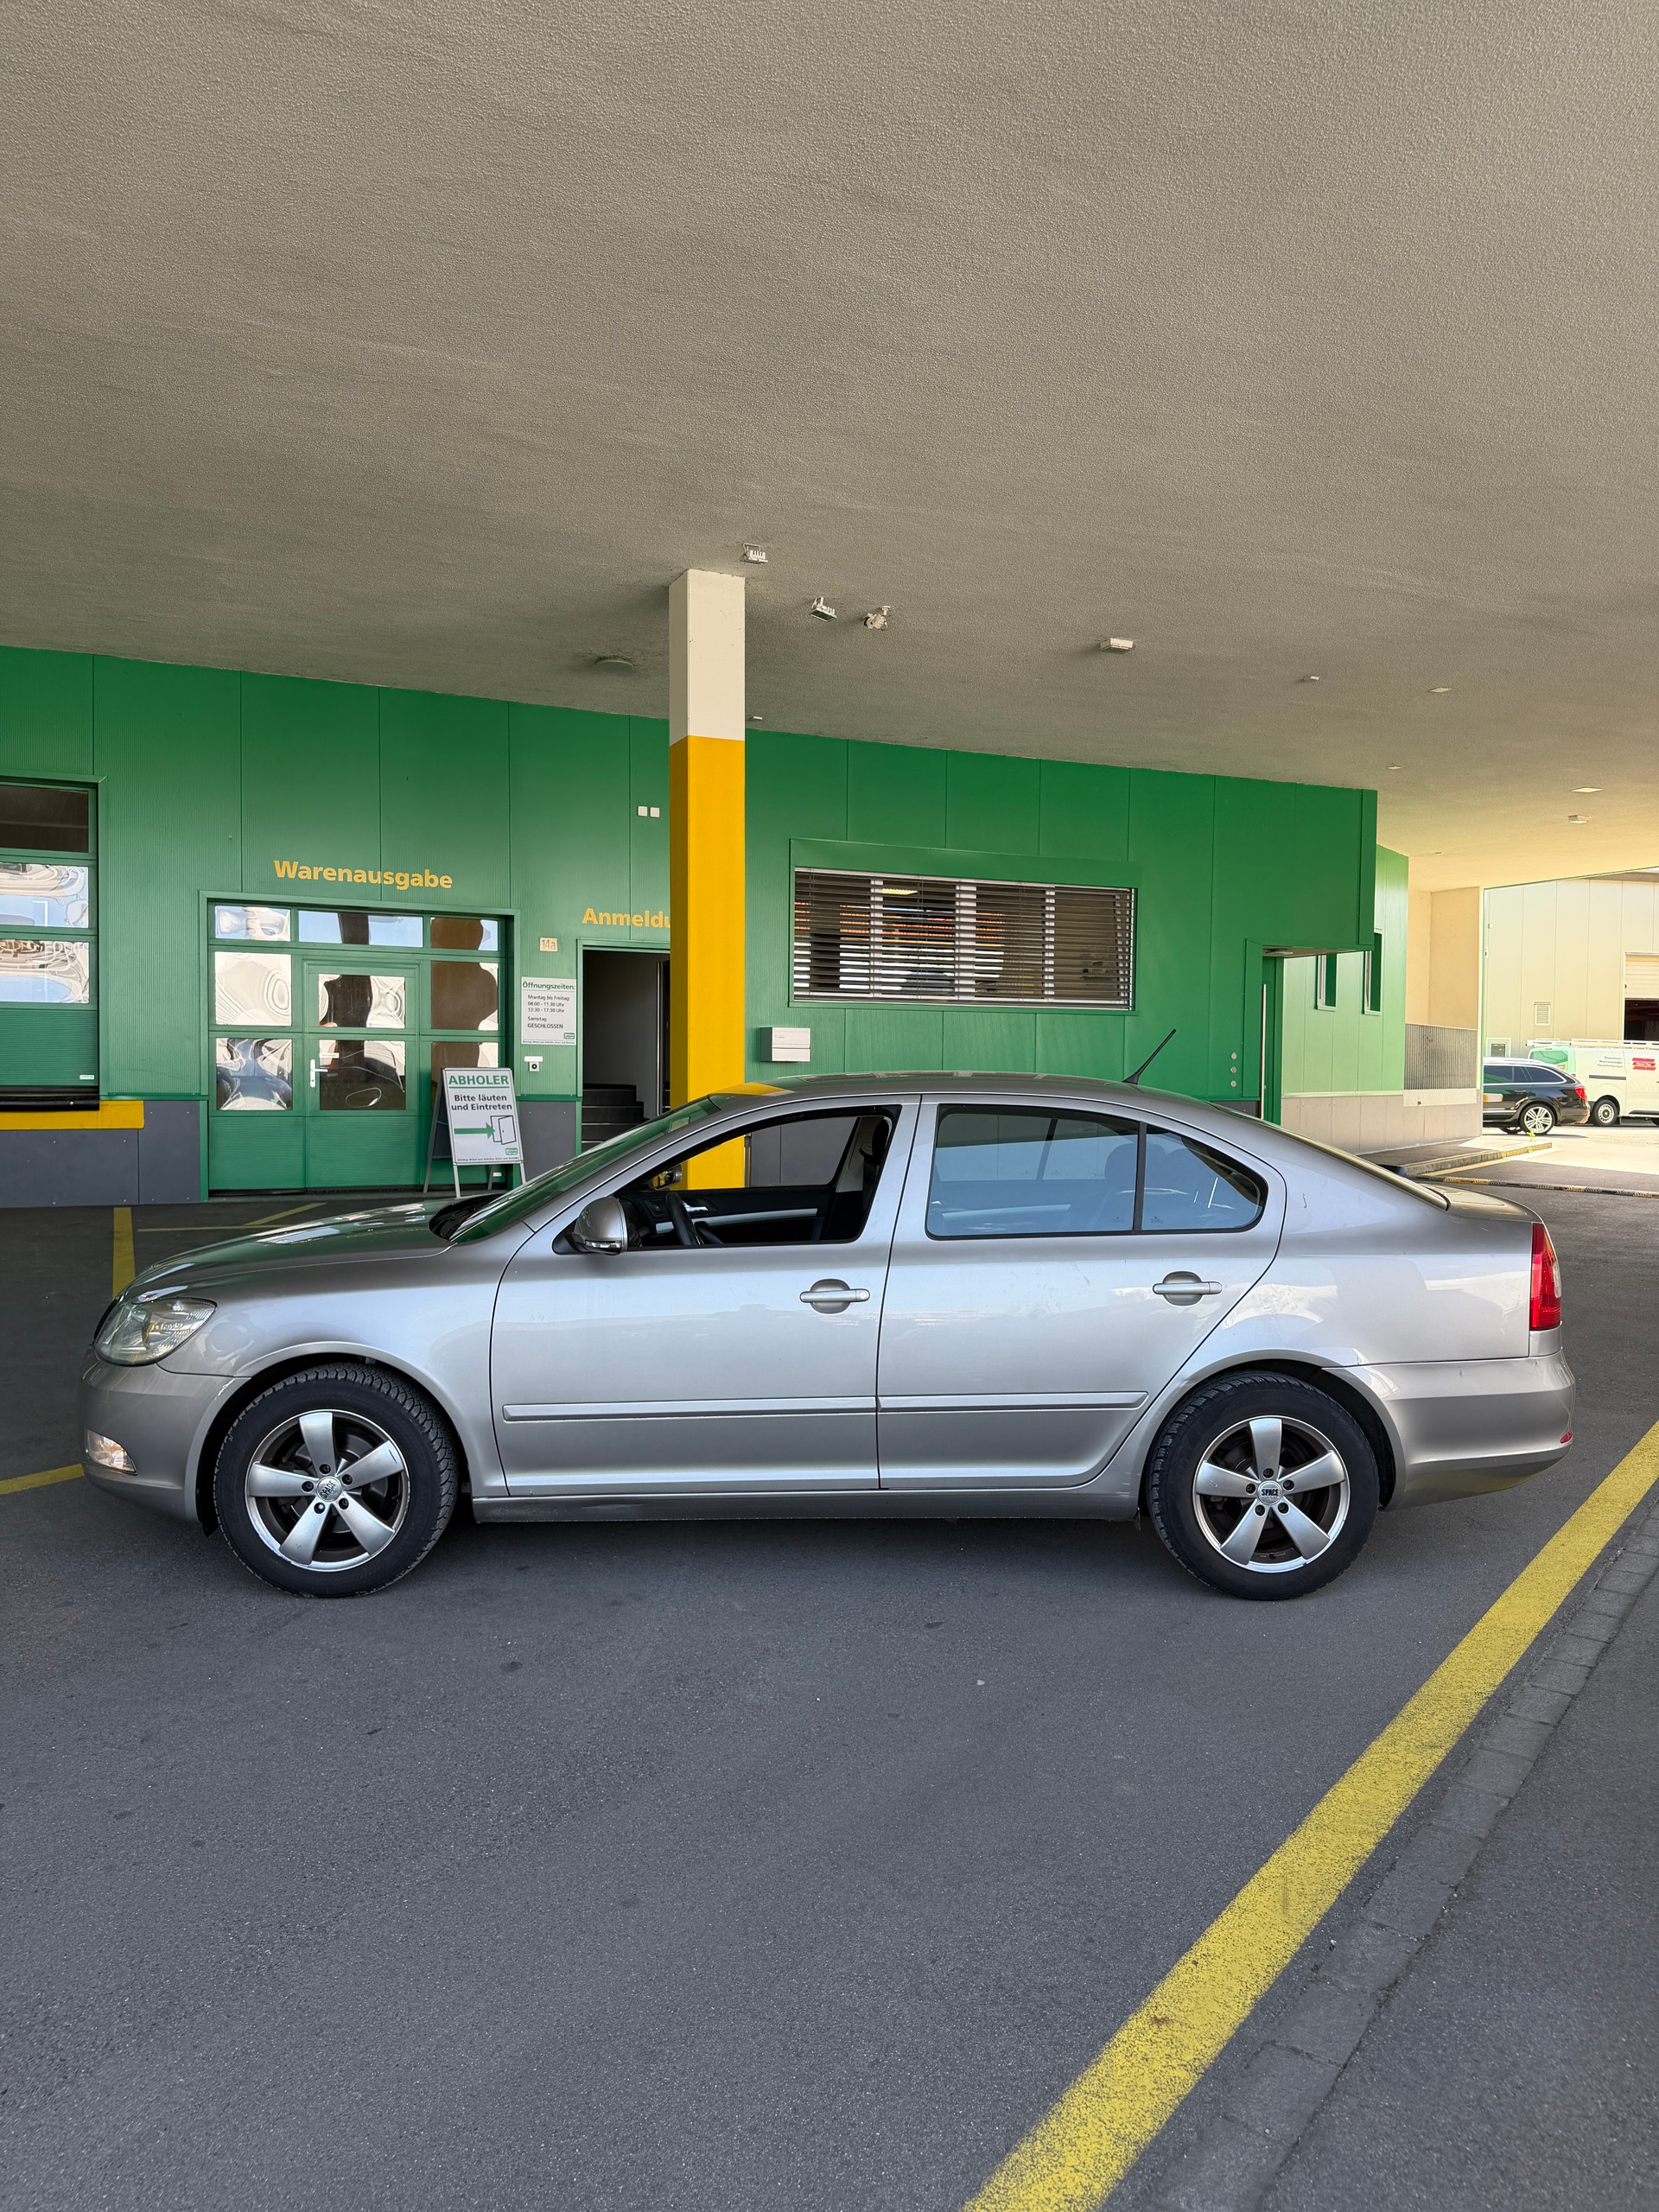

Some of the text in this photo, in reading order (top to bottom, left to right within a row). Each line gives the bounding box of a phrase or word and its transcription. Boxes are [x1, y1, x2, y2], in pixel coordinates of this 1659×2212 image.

[273, 860, 453, 891] Warenausgabe
[541, 939, 556, 950] 14a
[523, 982, 575, 990] Öffnungszeiten:
[448, 1075, 509, 1085] ABHOLER
